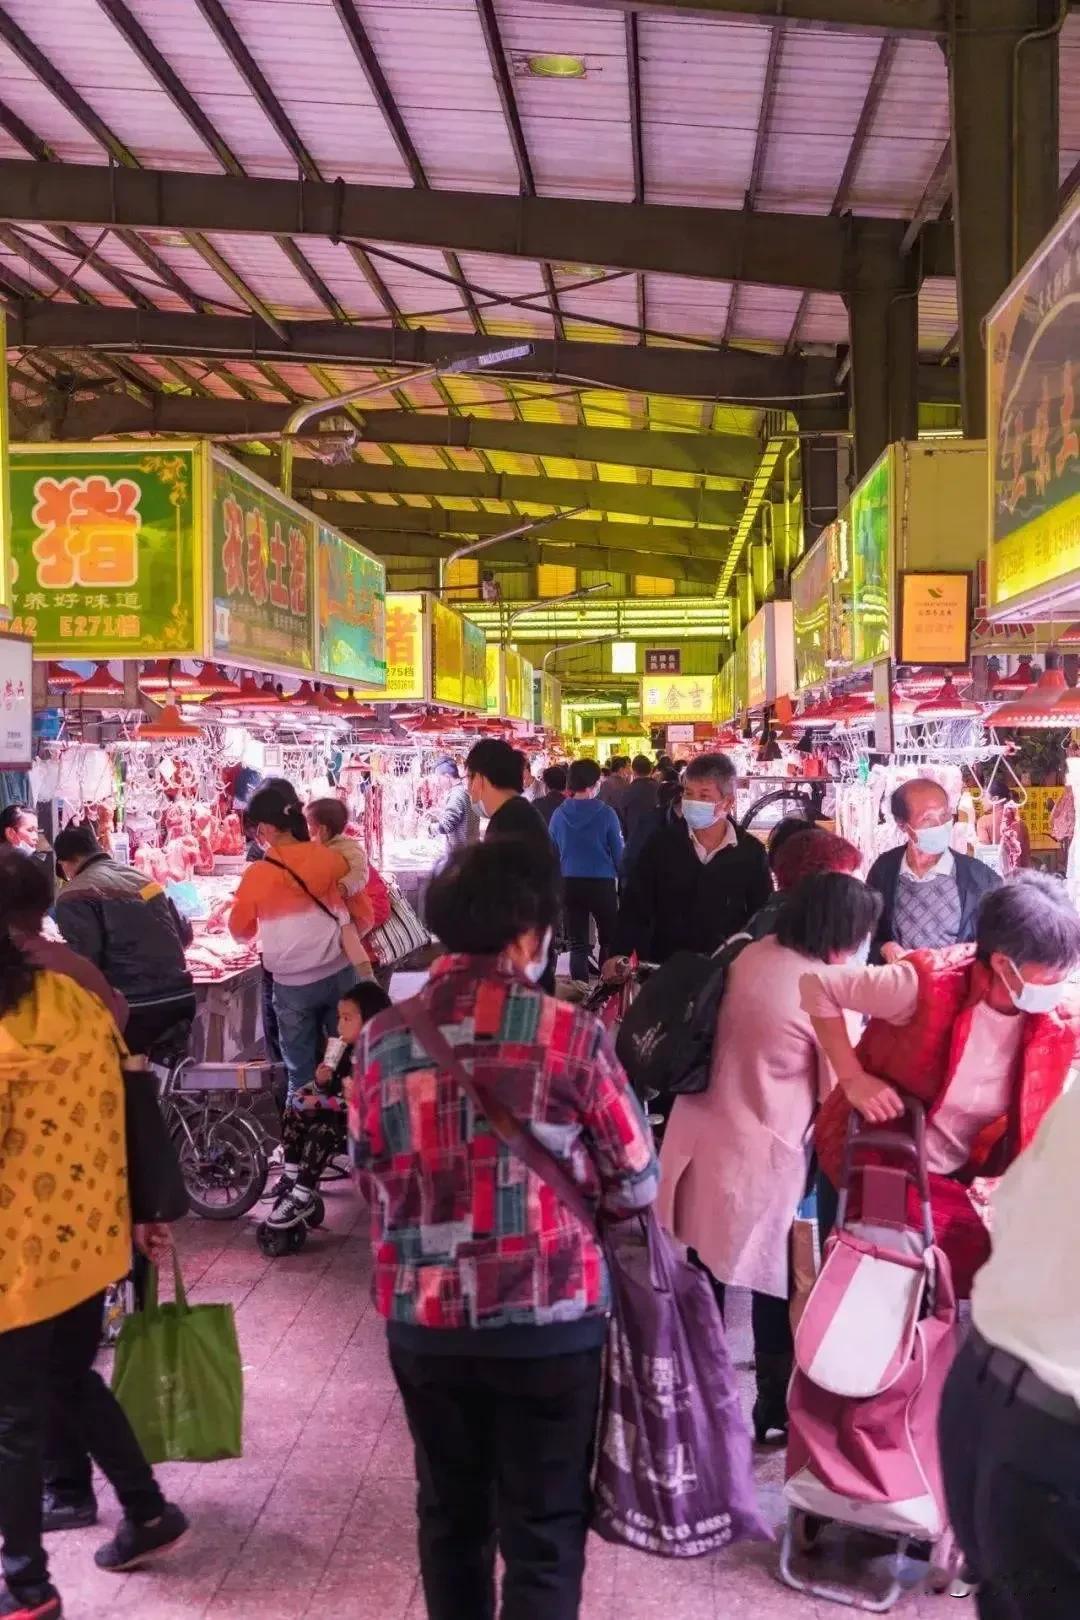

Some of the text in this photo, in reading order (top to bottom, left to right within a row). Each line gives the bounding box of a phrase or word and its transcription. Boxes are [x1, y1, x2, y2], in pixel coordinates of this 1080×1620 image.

[14, 476, 141, 589] 猪
[12, 592, 142, 610] 养好味道
